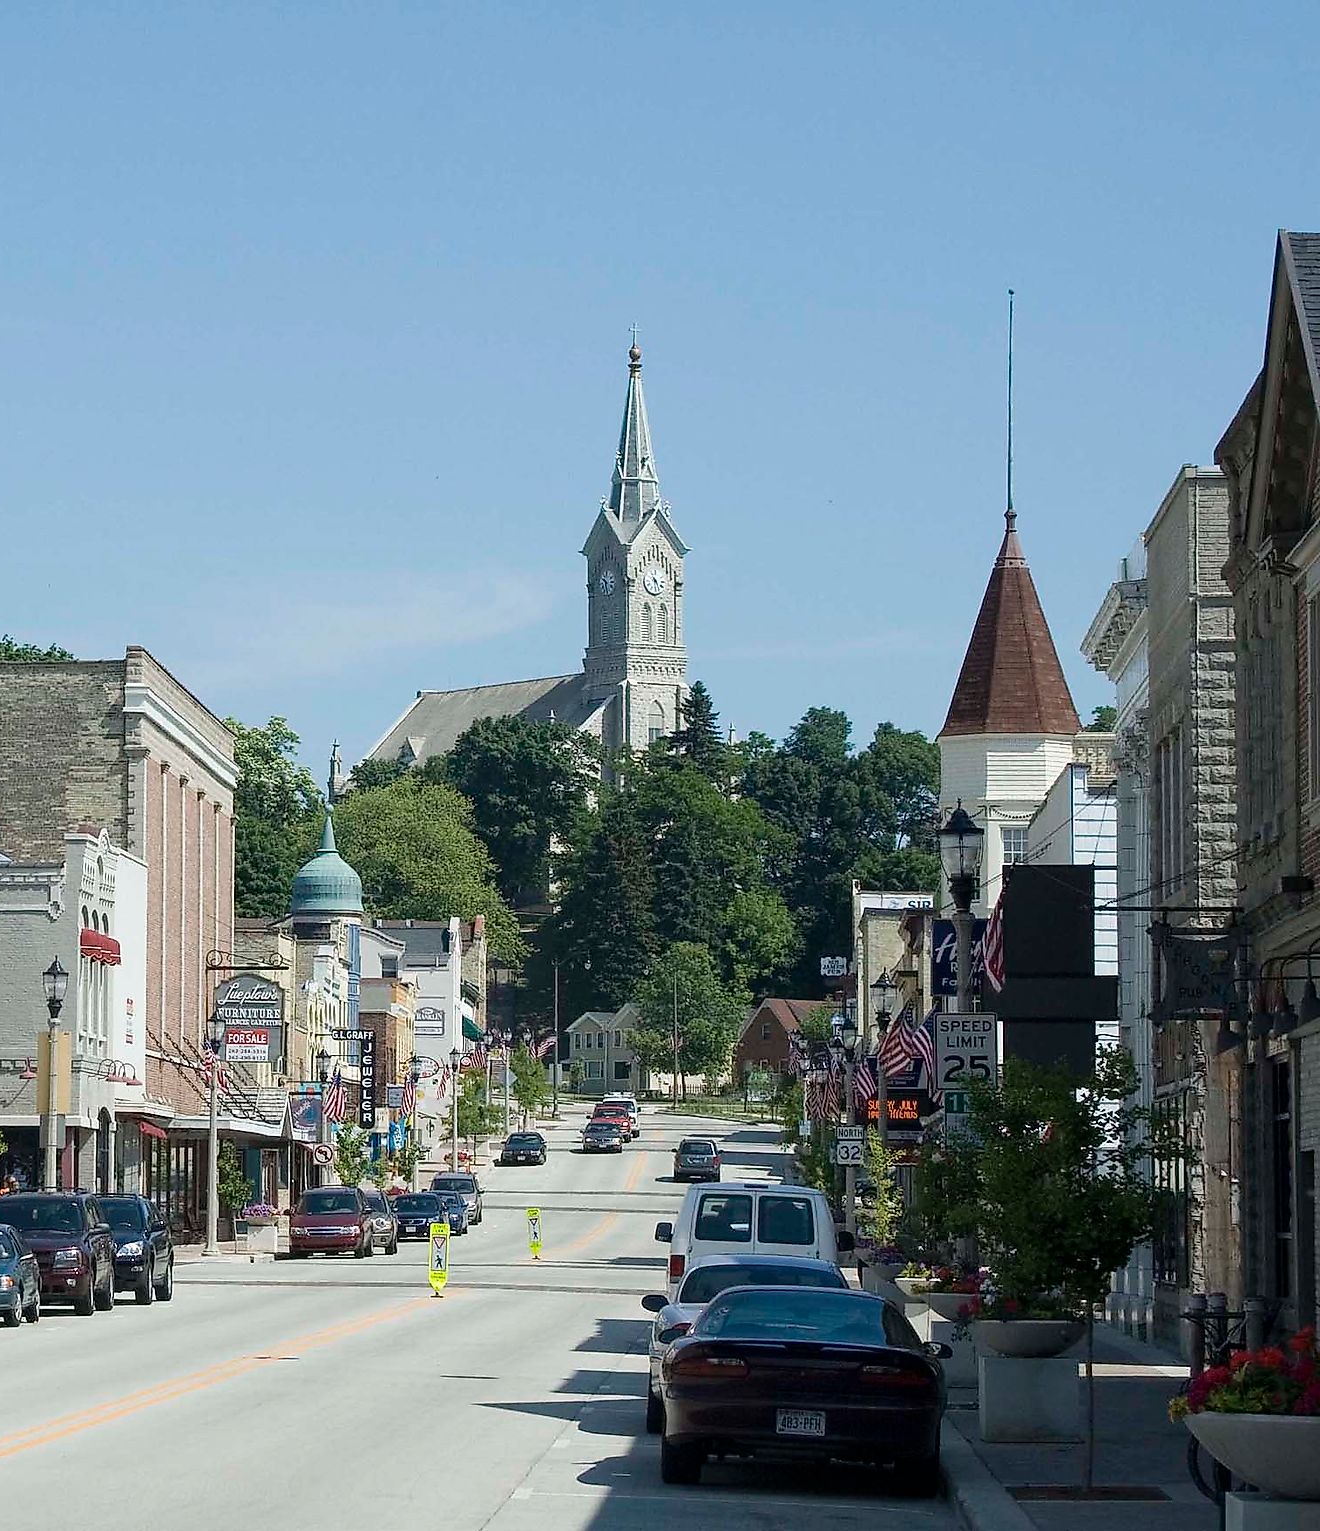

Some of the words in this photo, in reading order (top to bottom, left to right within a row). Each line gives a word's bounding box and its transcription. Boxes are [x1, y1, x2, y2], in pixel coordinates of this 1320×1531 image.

[217, 983, 278, 1005] Lueptow's
[217, 1008, 280, 1019] FURNITURE
[940, 1021, 992, 1032] SPEED
[228, 1034, 245, 1044] FOR
[246, 1034, 267, 1044] SALE
[946, 1036, 987, 1048] LIMIT
[943, 1055, 990, 1083] 25
[362, 1042, 372, 1122] JEWELER
[839, 1129, 862, 1137] NORTH
[840, 1145, 860, 1160] 32
